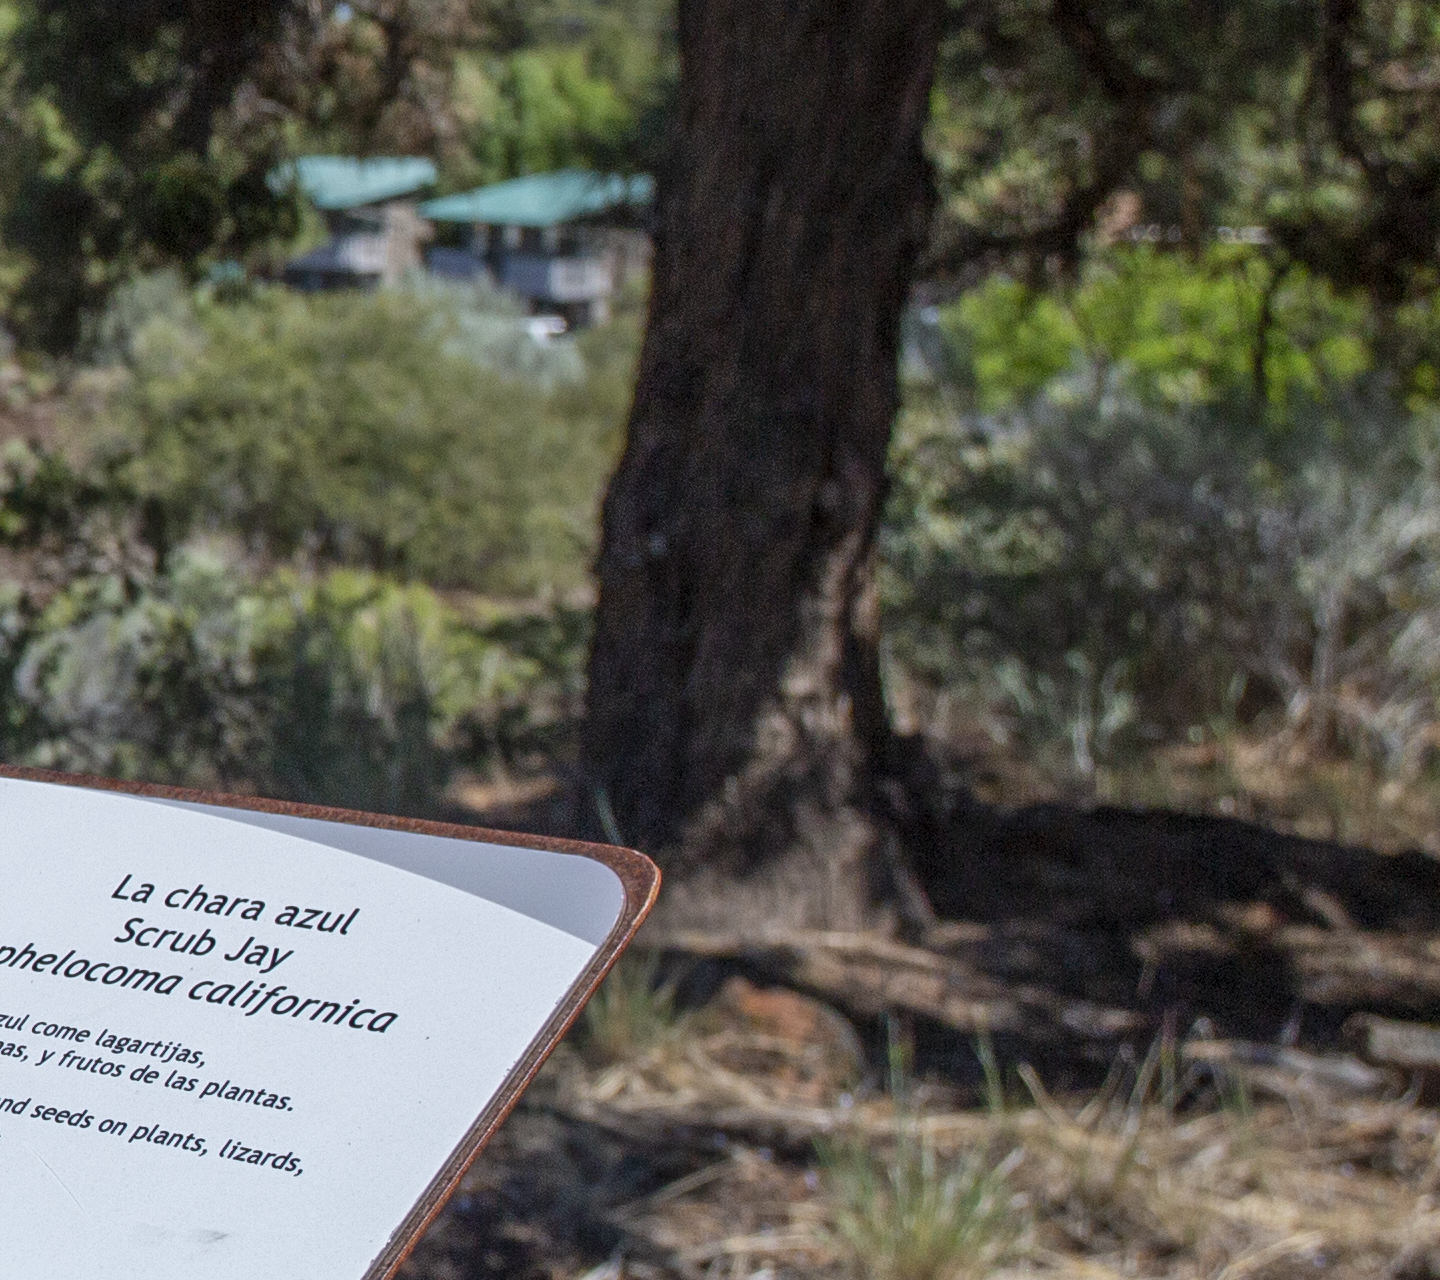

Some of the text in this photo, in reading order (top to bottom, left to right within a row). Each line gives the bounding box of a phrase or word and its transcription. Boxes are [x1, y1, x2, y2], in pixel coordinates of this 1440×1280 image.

[111, 873, 361, 936] La chara azul
[113, 917, 295, 974] Scrub Jay
[187, 980, 399, 1034] californica
[31, 1021, 91, 1043] come
[94, 1028, 205, 1069] lagartijas,
[34, 1049, 56, 1067] y
[57, 1049, 126, 1078] frutos
[129, 1064, 160, 1084] de
[164, 1069, 200, 1092] las
[198, 1079, 294, 1112] plantas.
[29, 1104, 95, 1129] seeds
[98, 1118, 128, 1137] on
[127, 1123, 208, 1157] plants,
[218, 1138, 304, 1177] lizards,
